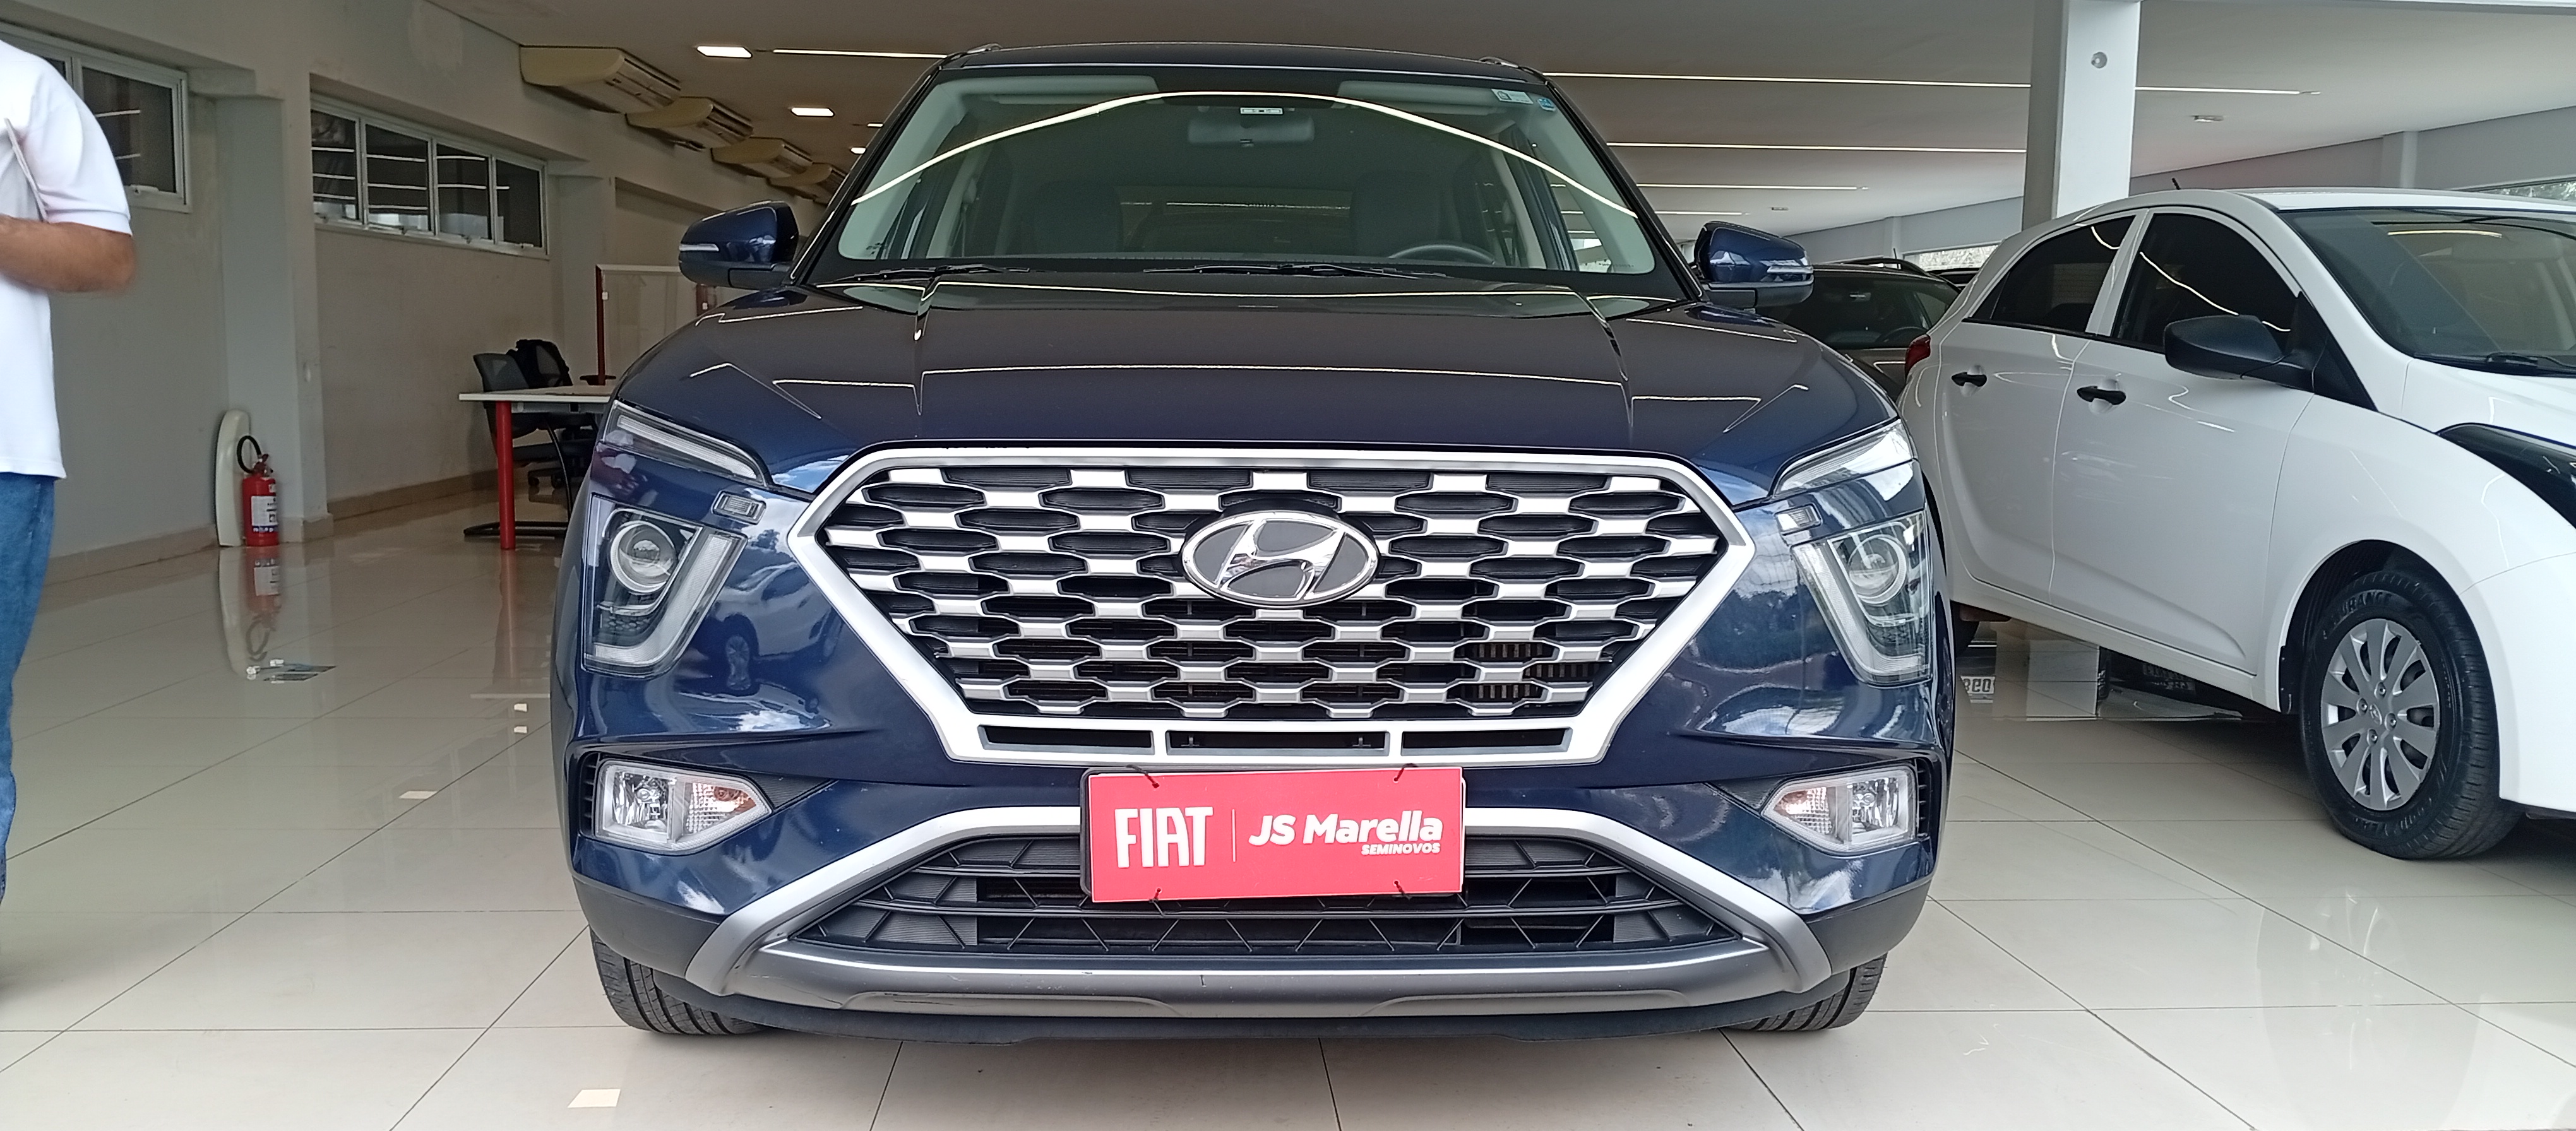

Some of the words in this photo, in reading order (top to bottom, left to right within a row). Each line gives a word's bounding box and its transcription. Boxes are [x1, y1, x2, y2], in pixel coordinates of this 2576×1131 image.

[1115, 807, 1213, 868] FIAT
[1248, 815, 1296, 846] JS
[1303, 810, 1443, 844] Marella
[1361, 842, 1440, 855] SEMINOVOS
